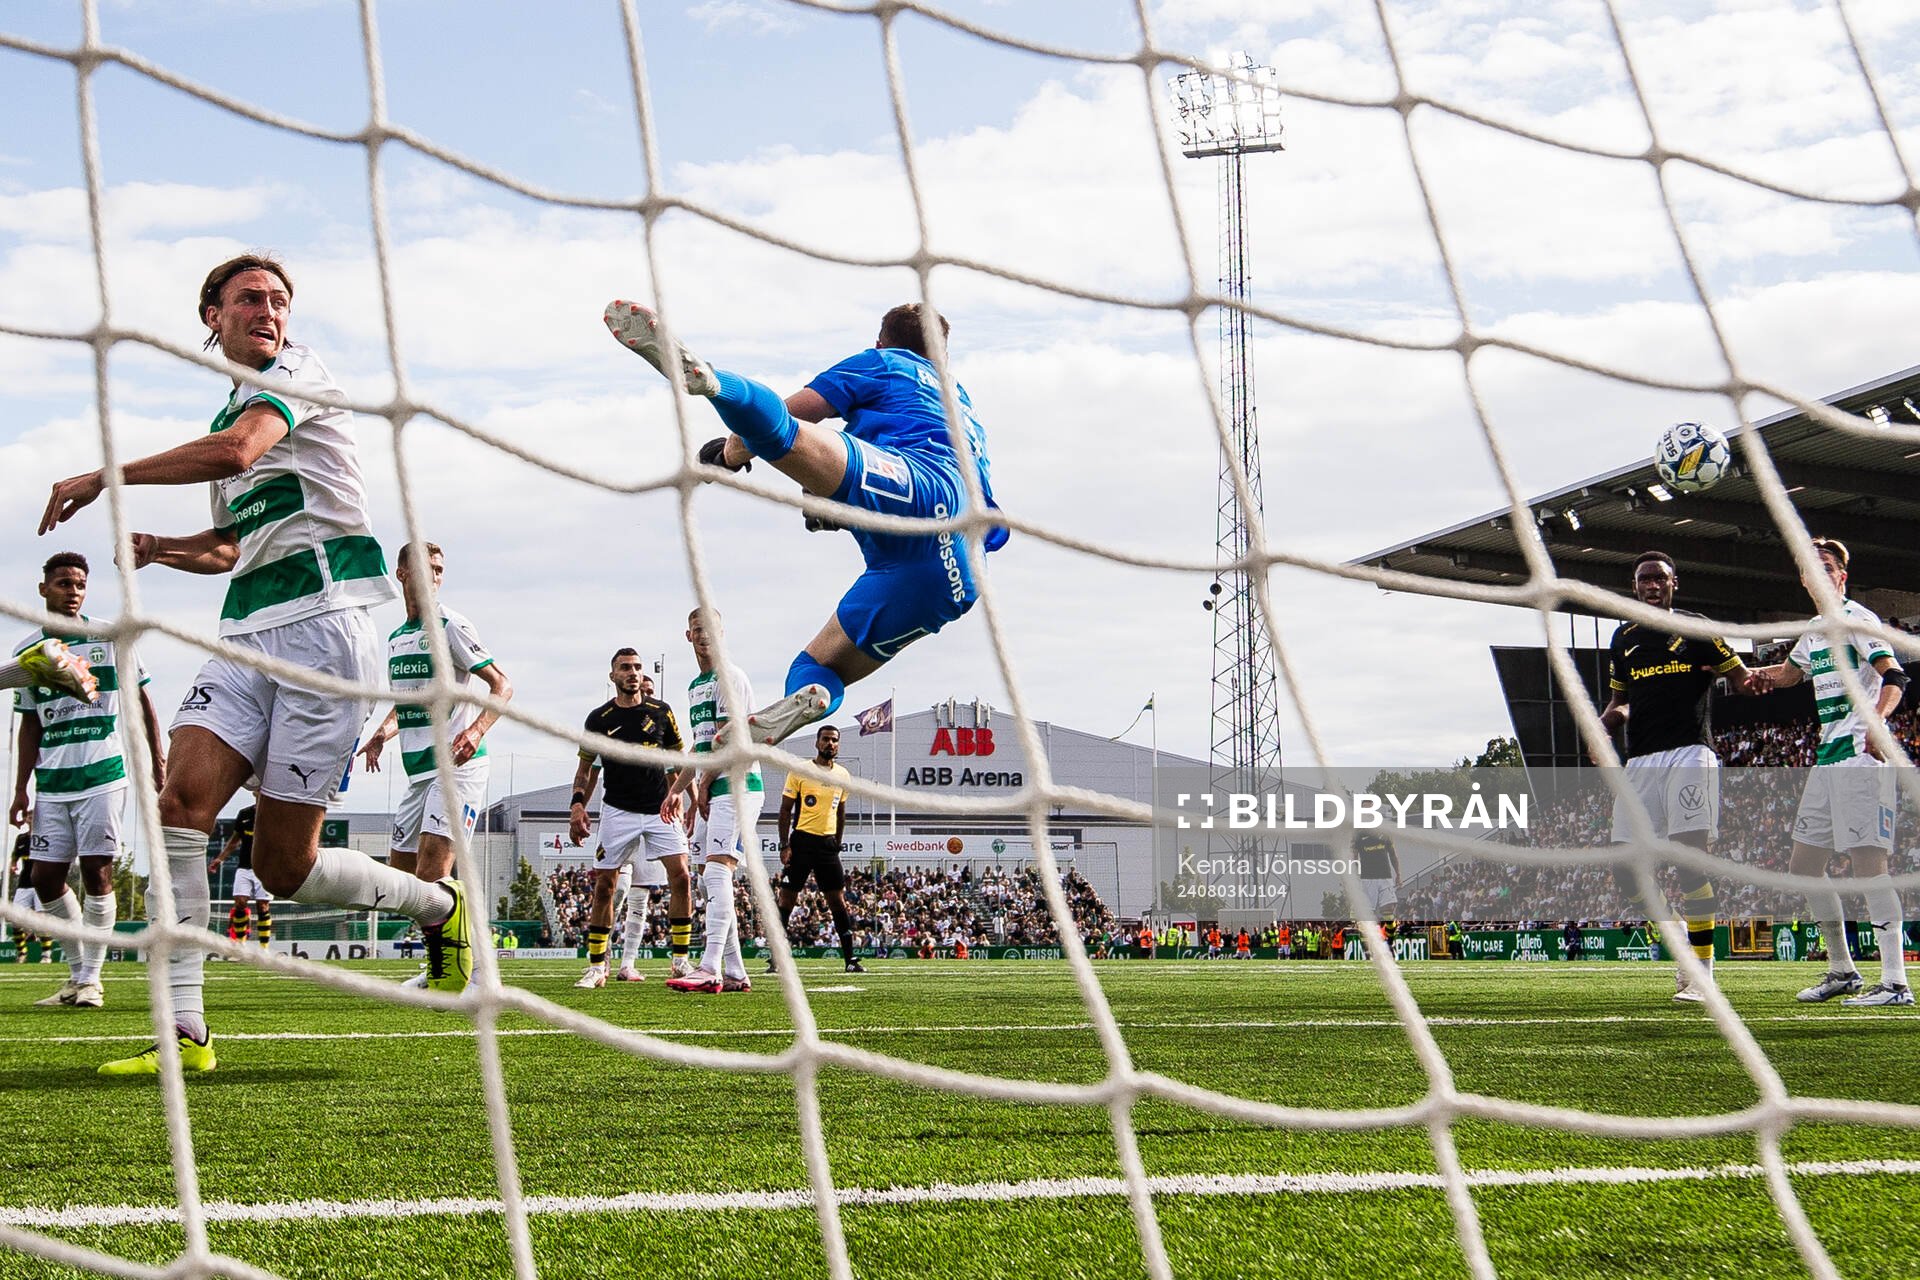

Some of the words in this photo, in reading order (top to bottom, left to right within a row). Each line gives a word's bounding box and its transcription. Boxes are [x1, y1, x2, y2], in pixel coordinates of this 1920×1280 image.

[235, 499, 267, 523] nergy
[934, 503, 966, 602] aelssons
[929, 727, 995, 756] ABB
[904, 767, 953, 786] ABB
[959, 767, 1023, 787] Arena
[886, 840, 945, 852] Swedbank
